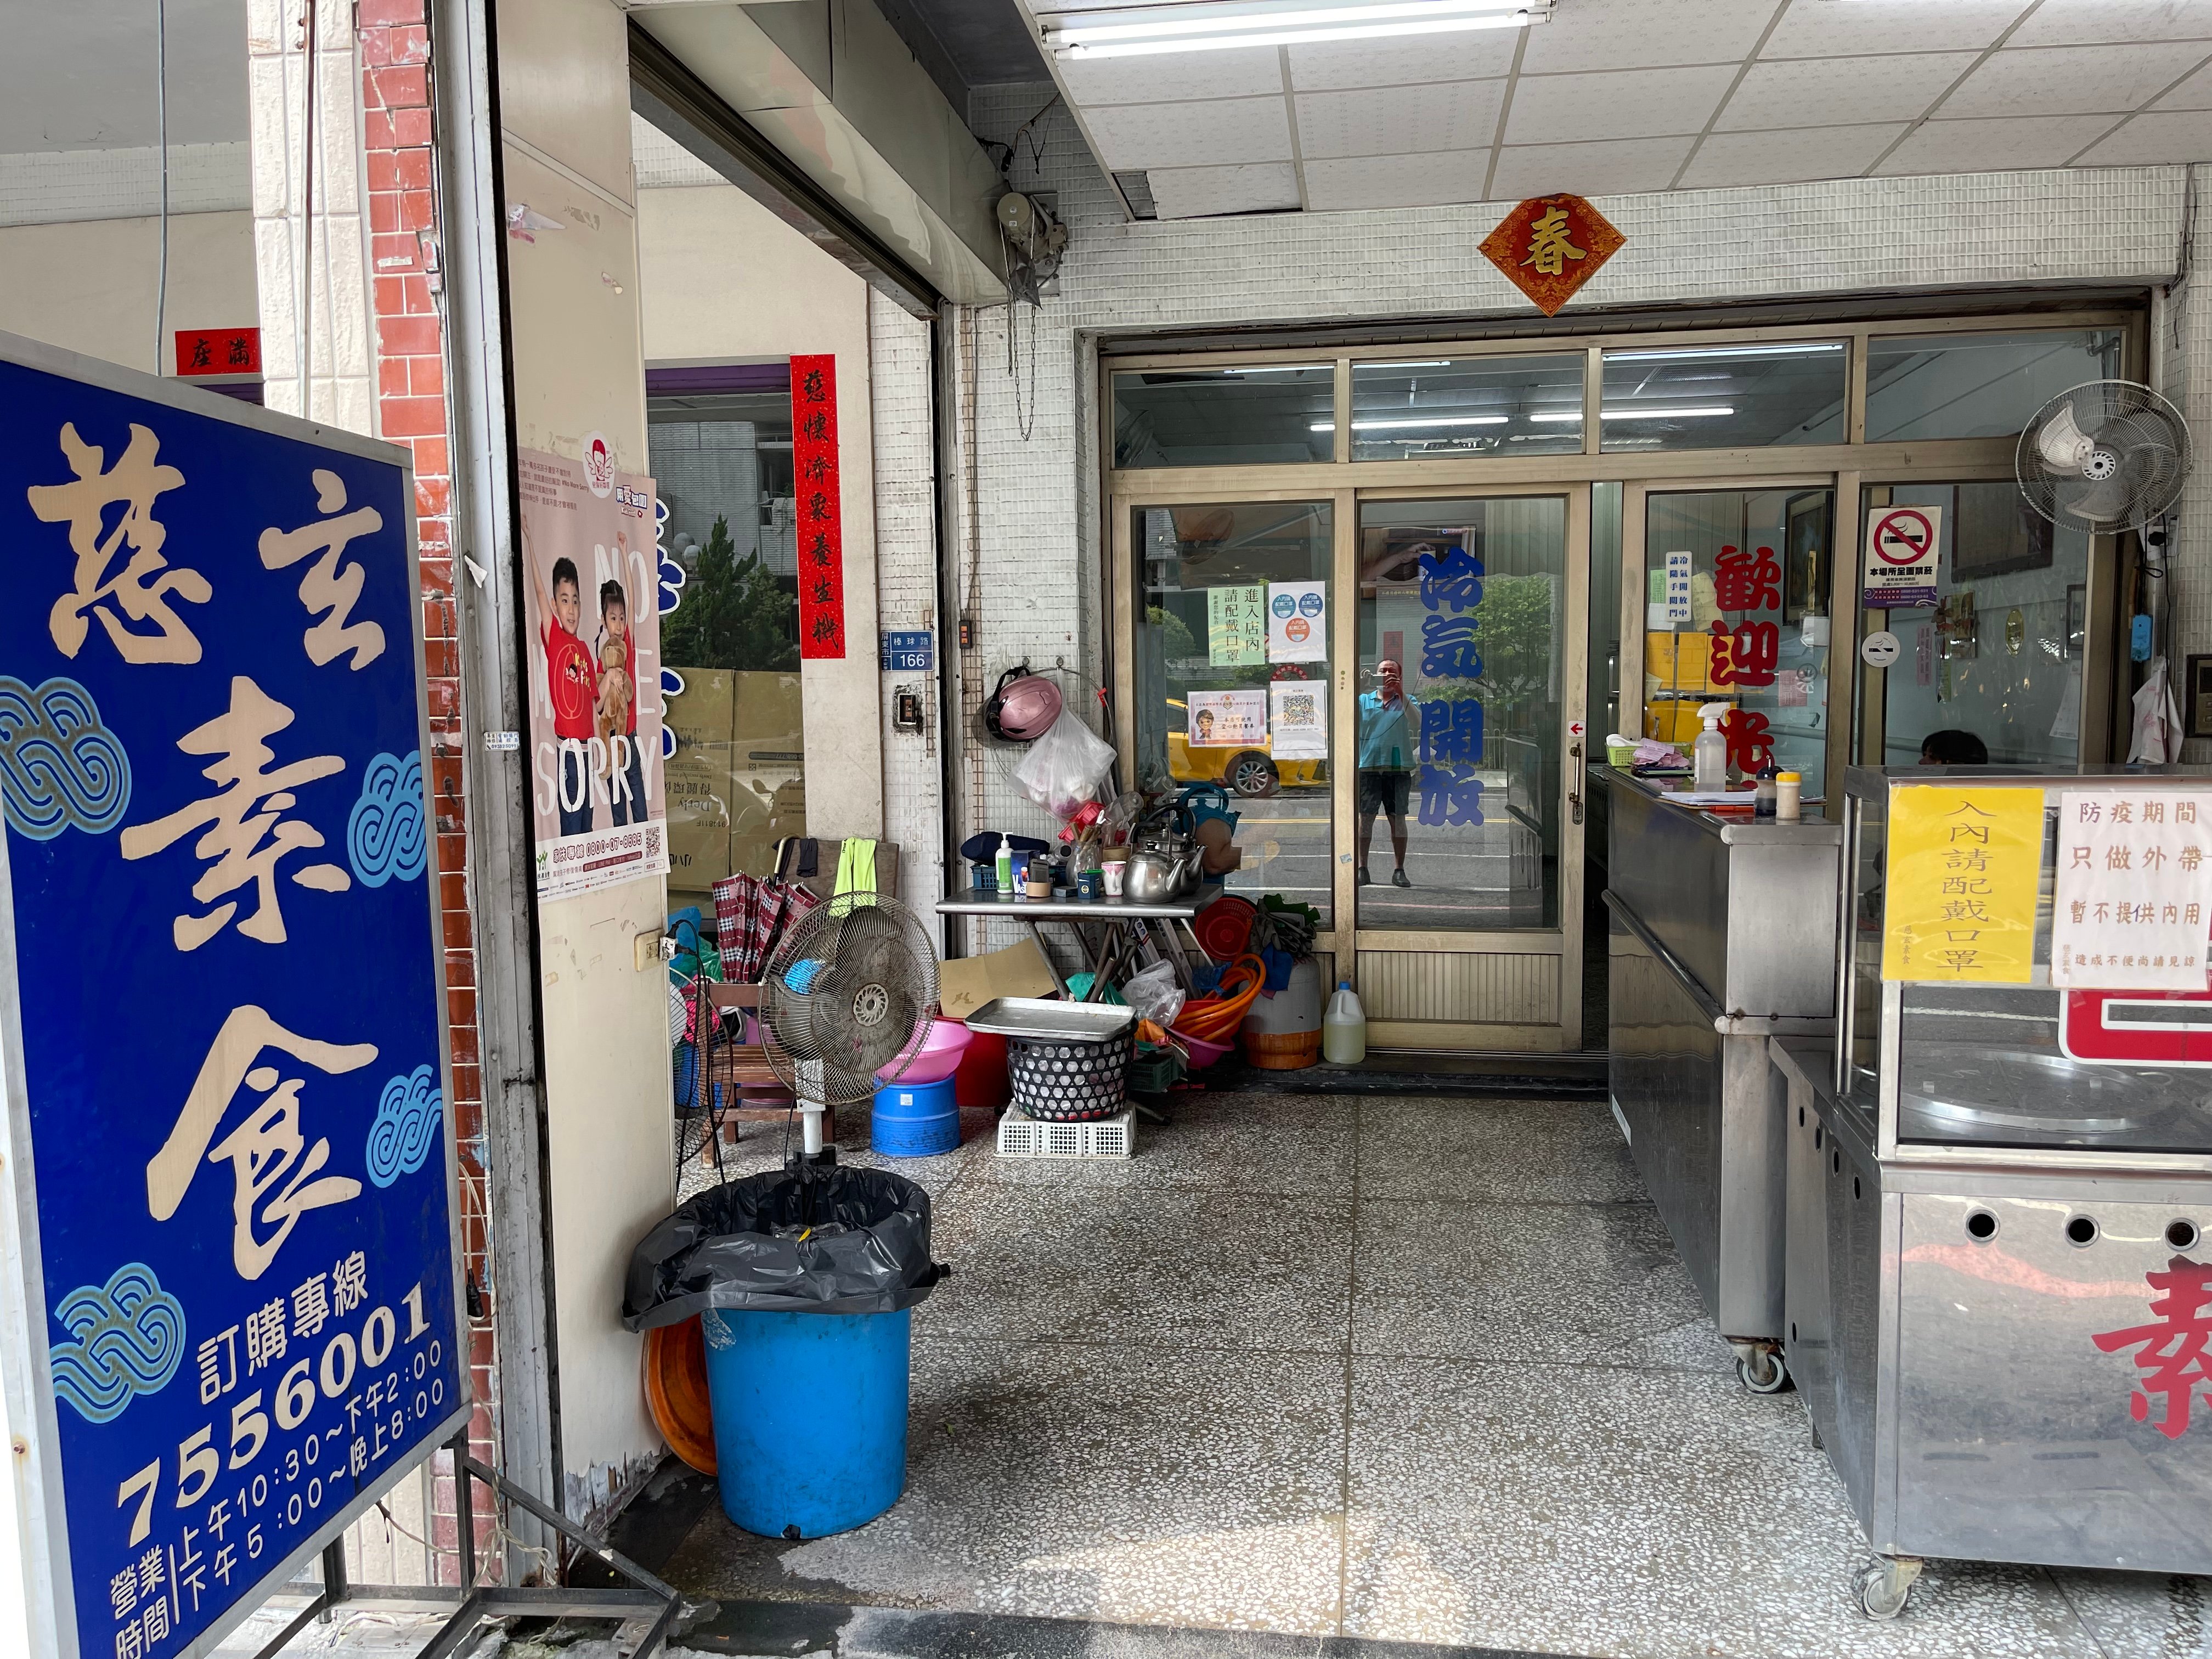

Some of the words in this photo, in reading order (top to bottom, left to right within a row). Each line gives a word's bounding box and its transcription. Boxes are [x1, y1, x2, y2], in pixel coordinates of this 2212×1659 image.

[1520, 206, 1588, 275] 春
[580, 483, 589, 493] Sorry
[594, 543, 651, 623] NO
[1669, 556, 1678, 617] 請隨手關門
[1679, 556, 1688, 617] 冷氣開放中
[881, 633, 890, 656] 屏東市
[894, 637, 929, 646] 棒球路
[1224, 589, 1240, 663] 請配戴口罩
[1244, 589, 1260, 652] 進入店內
[900, 653, 926, 667] 166
[1711, 545, 1781, 790] 歡迎光
[537, 736, 658, 816] SORRY
[678, 797, 712, 812] Derly
[2079, 801, 2196, 825] 防疫期間
[553, 845, 585, 864] 家扶專線
[586, 832, 642, 856] 0800-07-8585
[2070, 845, 2203, 872] 只做外帶
[1937, 800, 1997, 972] 入內請配戴口罩
[2070, 900, 2200, 926] 暫不提供內用
[2075, 953, 2196, 967] 造成不便尚請見諒
[196, 1250, 369, 1406] 訂購專線
[117, 1281, 430, 1549] 7556001
[110, 1544, 166, 1620] 營業
[116, 1595, 170, 1659] 時間
